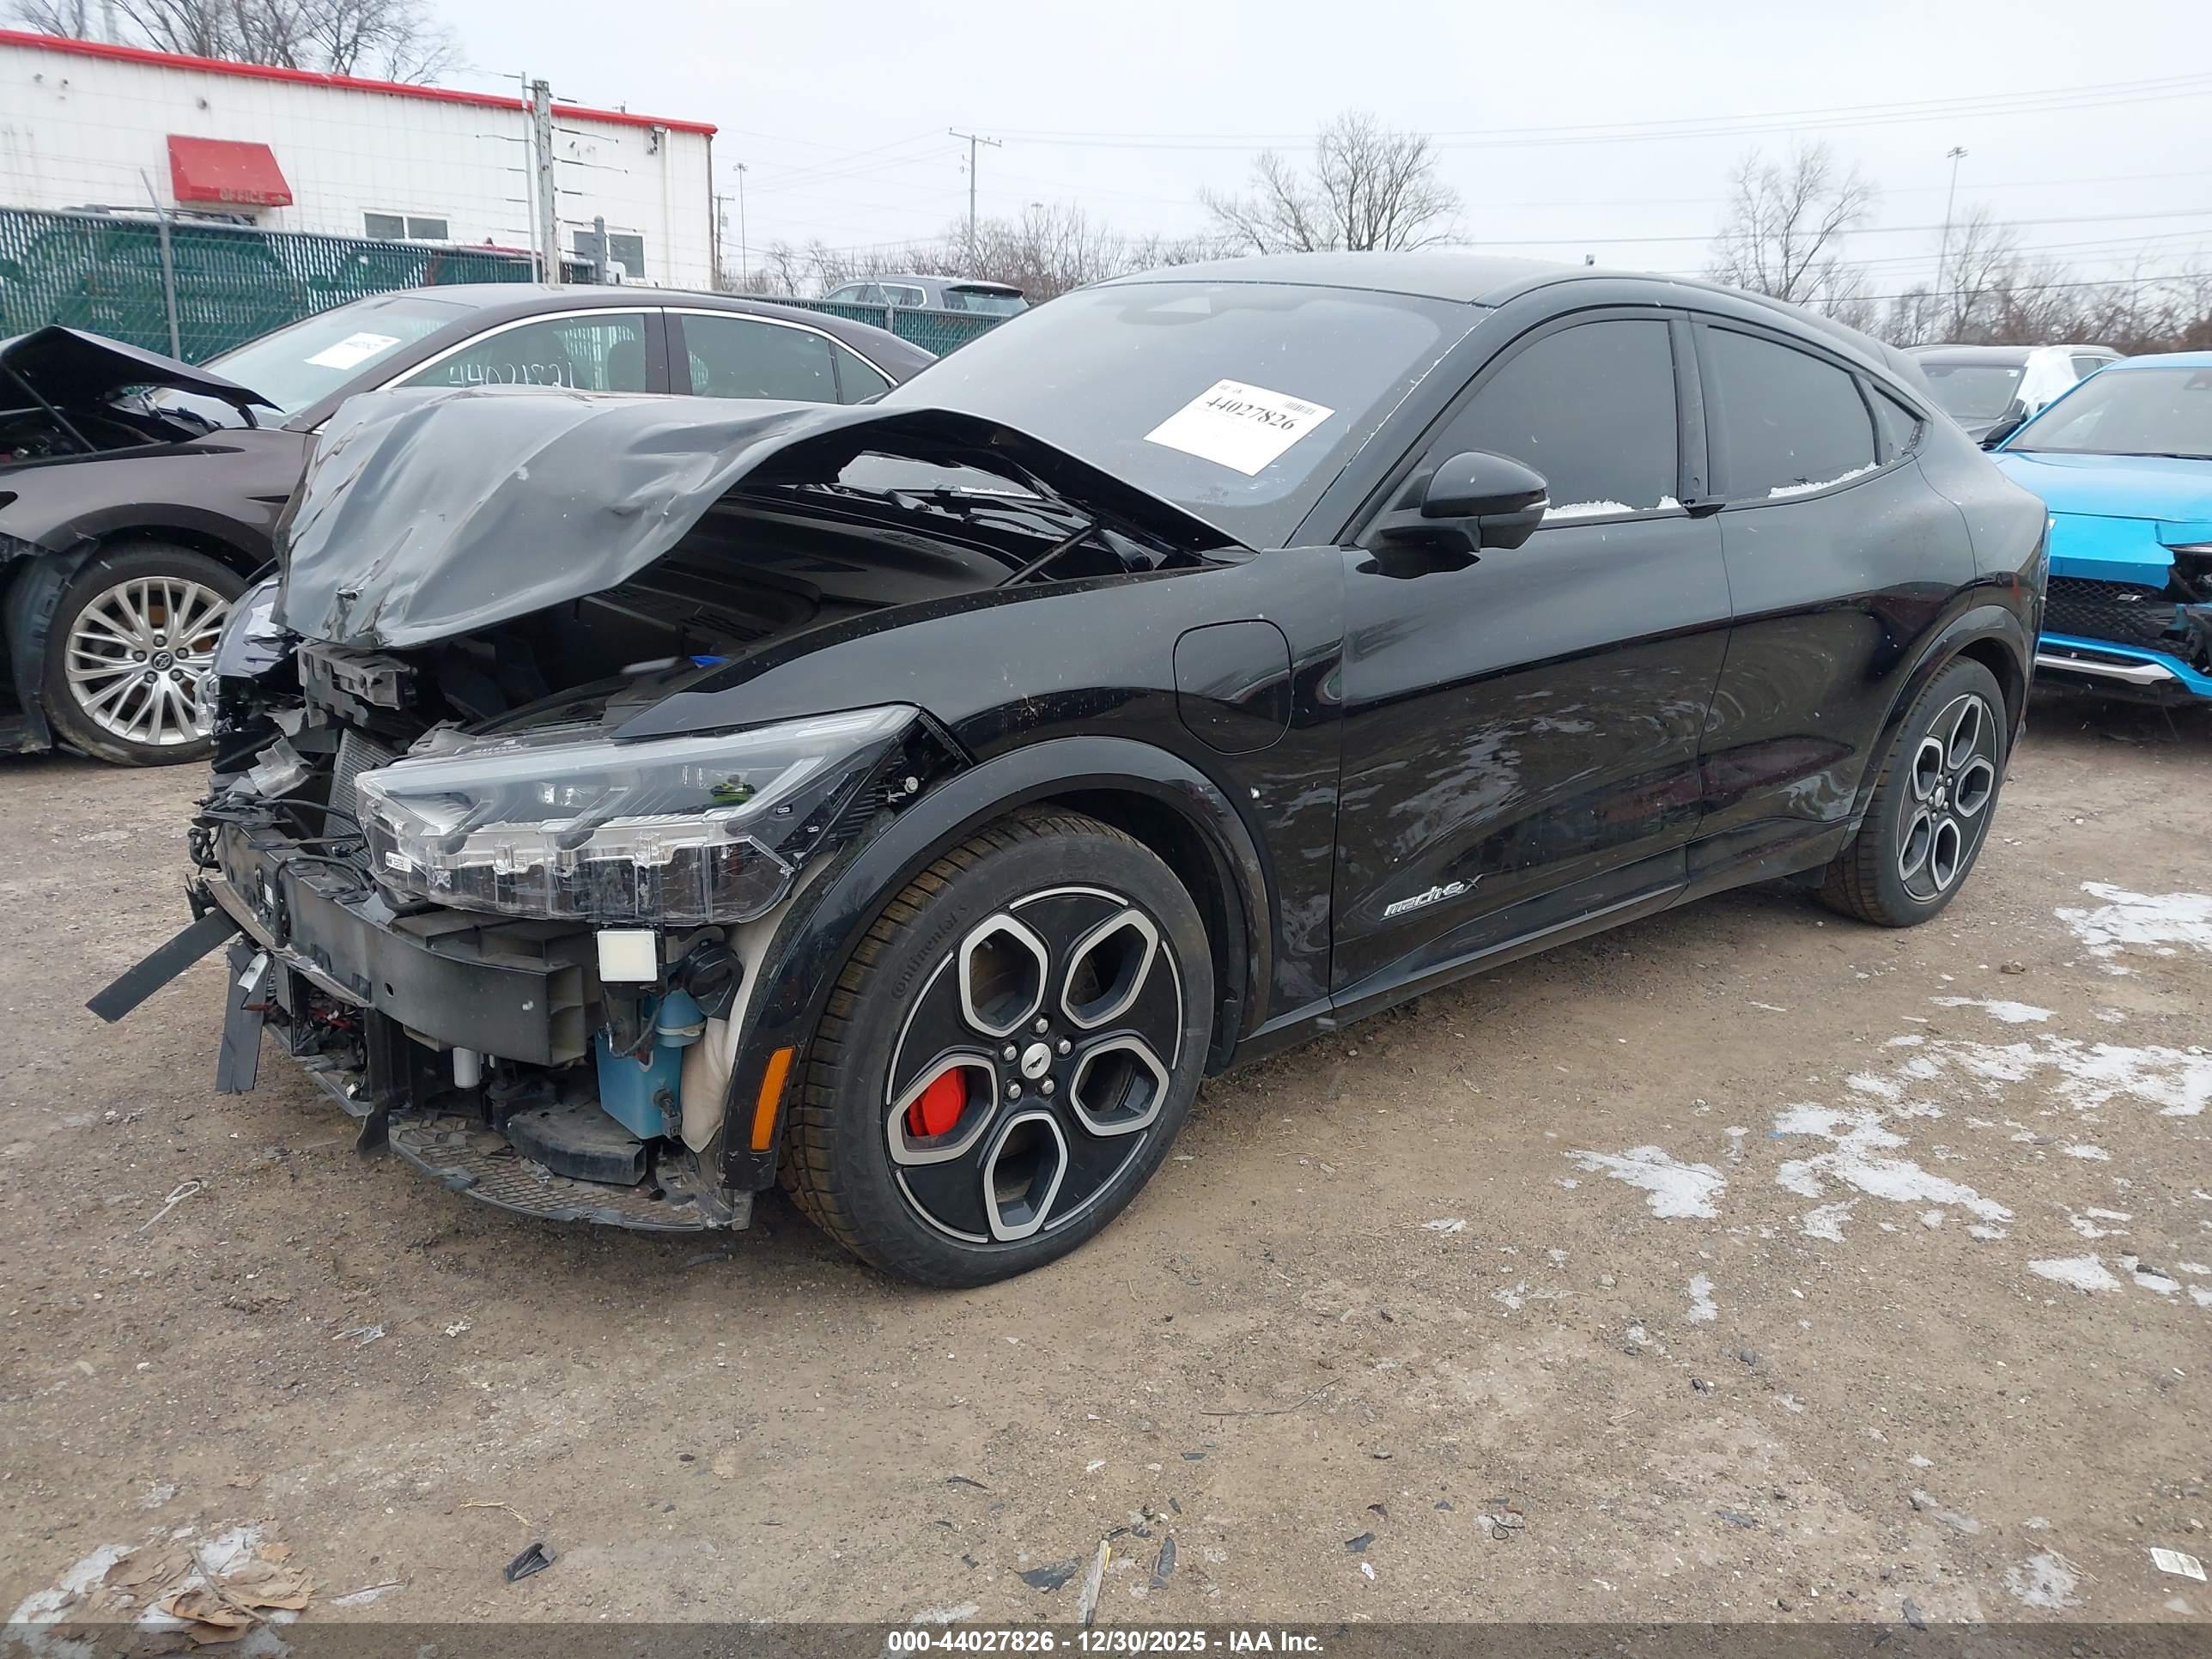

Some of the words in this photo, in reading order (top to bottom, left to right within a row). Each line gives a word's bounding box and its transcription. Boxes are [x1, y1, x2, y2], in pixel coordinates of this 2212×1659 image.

[220, 189, 265, 204] OFFICE
[1206, 397, 1299, 430] 44027826
[891, 910, 961, 1000] Continental
